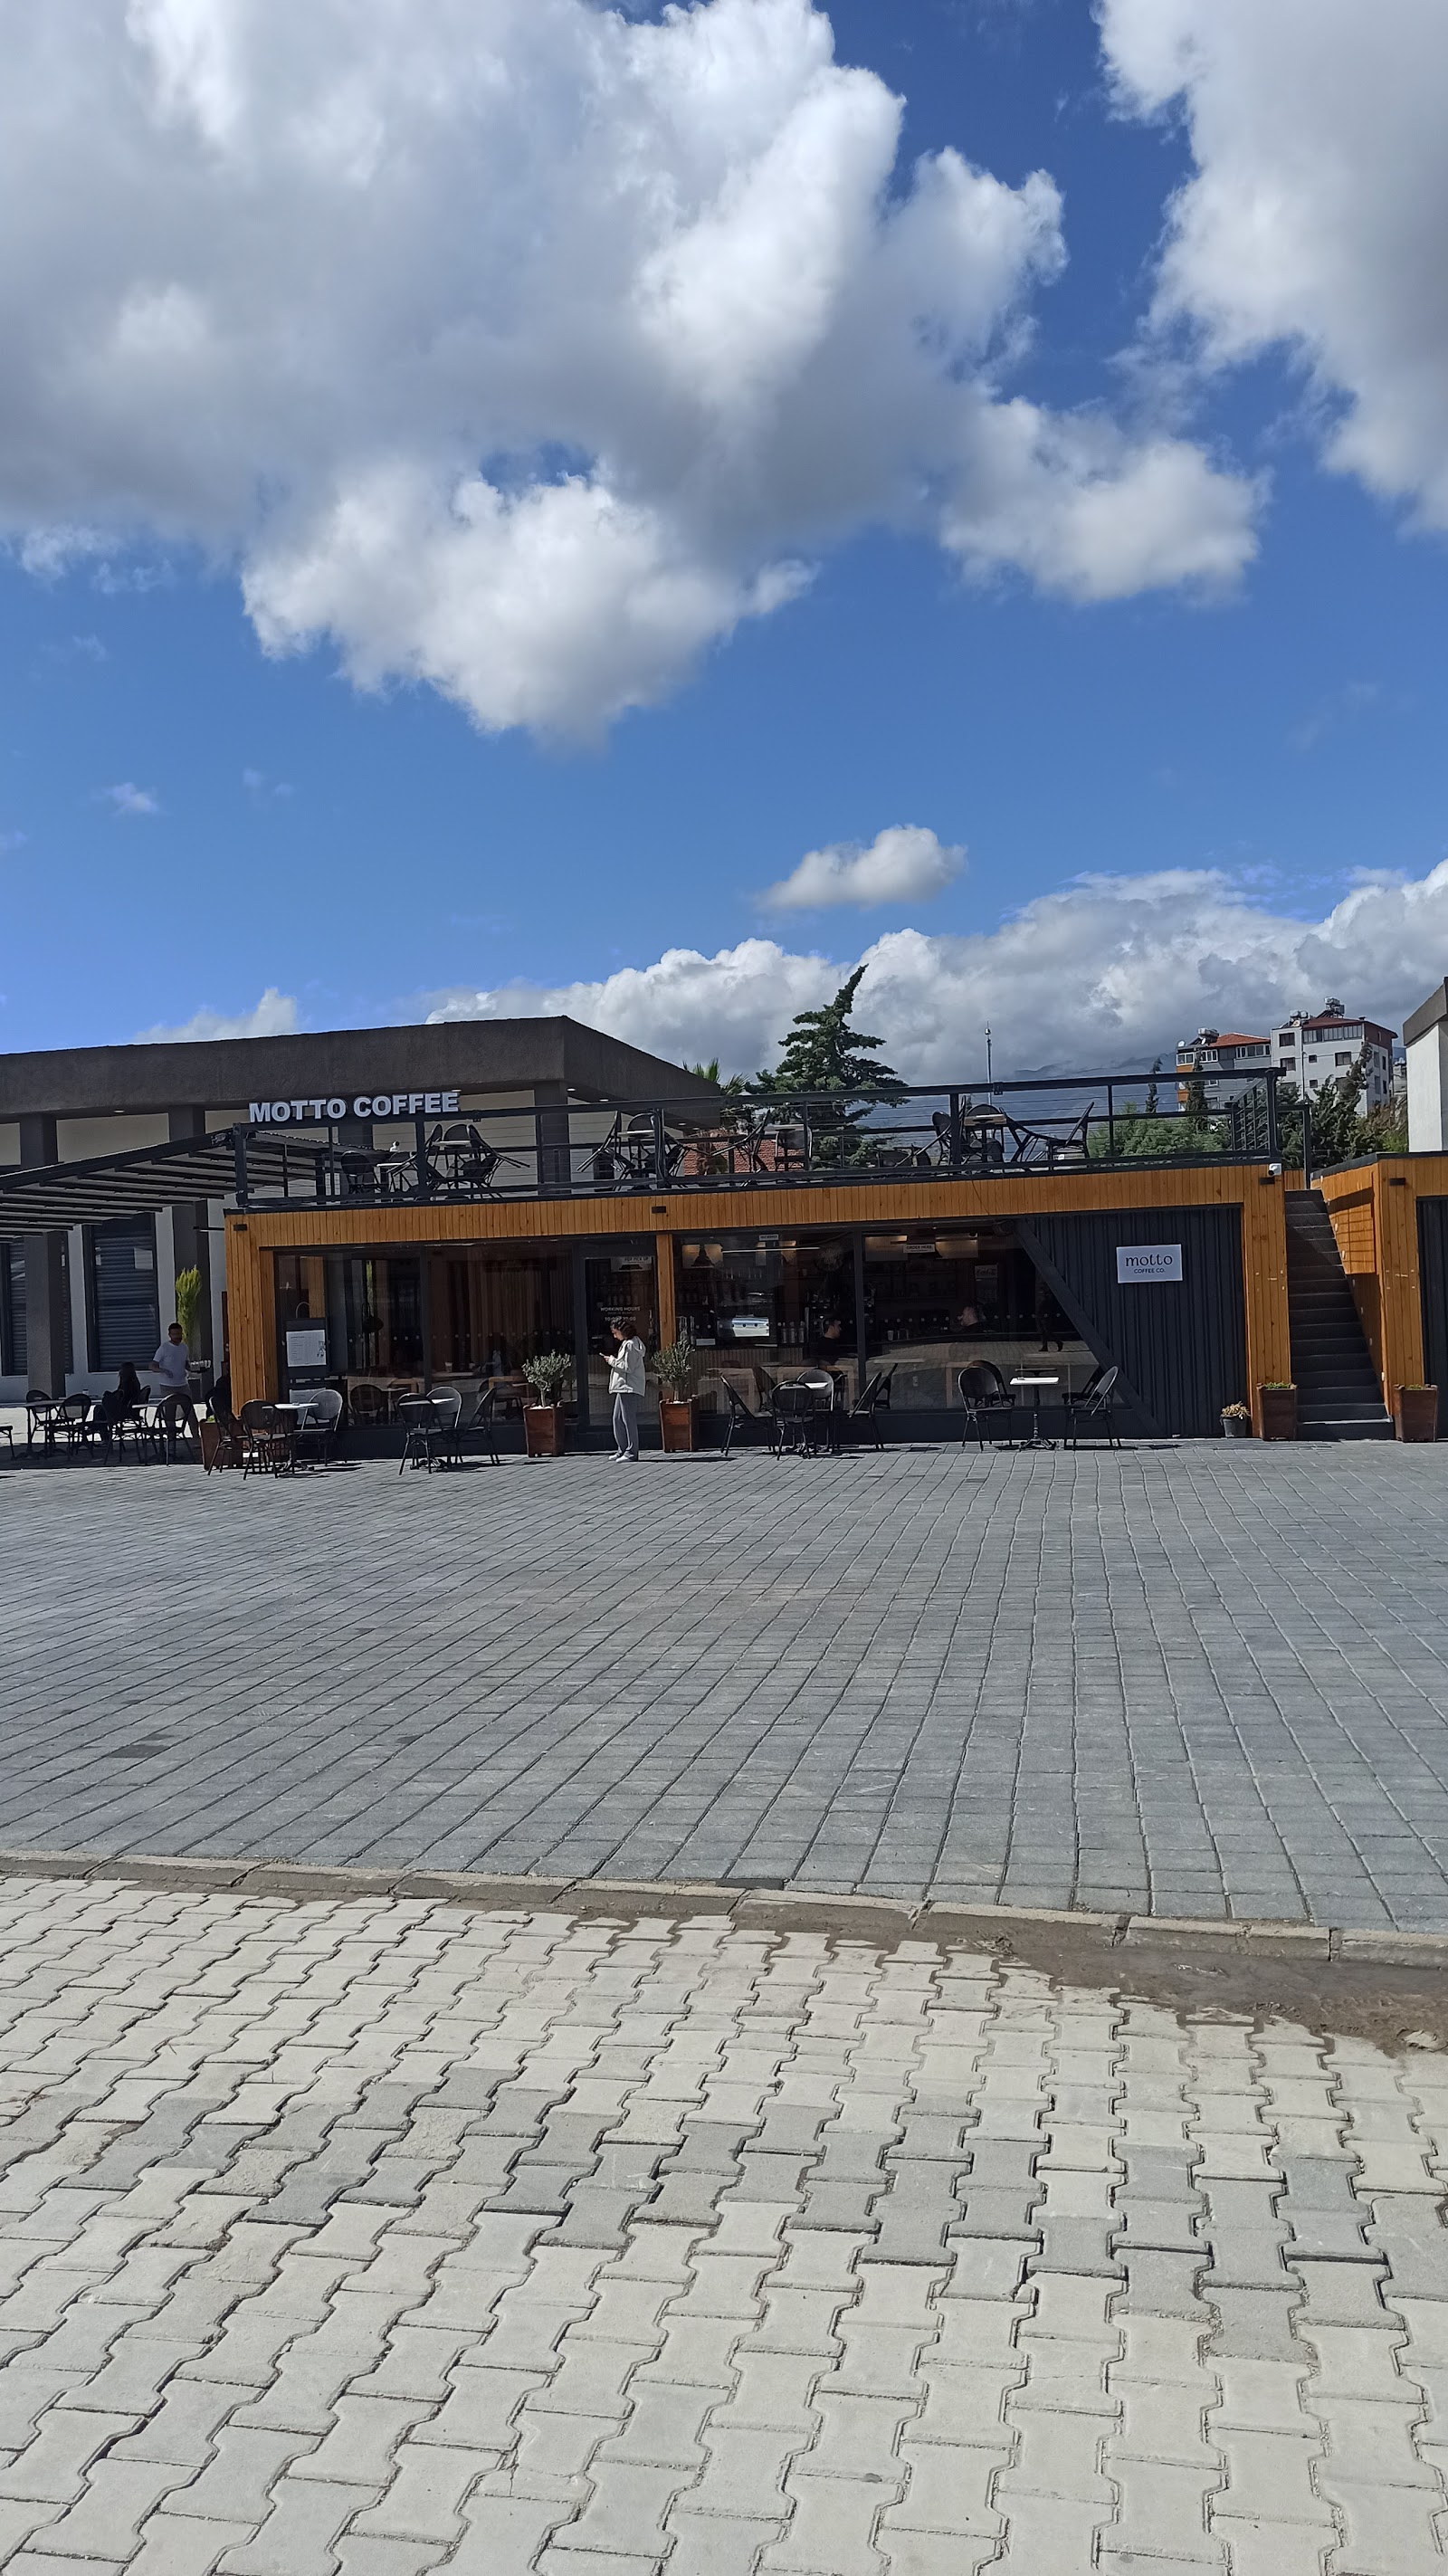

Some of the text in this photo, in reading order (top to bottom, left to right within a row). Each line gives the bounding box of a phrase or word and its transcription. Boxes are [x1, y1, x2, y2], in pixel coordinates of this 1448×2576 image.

[249, 1092, 460, 1122] MOTTO COFFEE
[1125, 1254, 1173, 1267] motto
